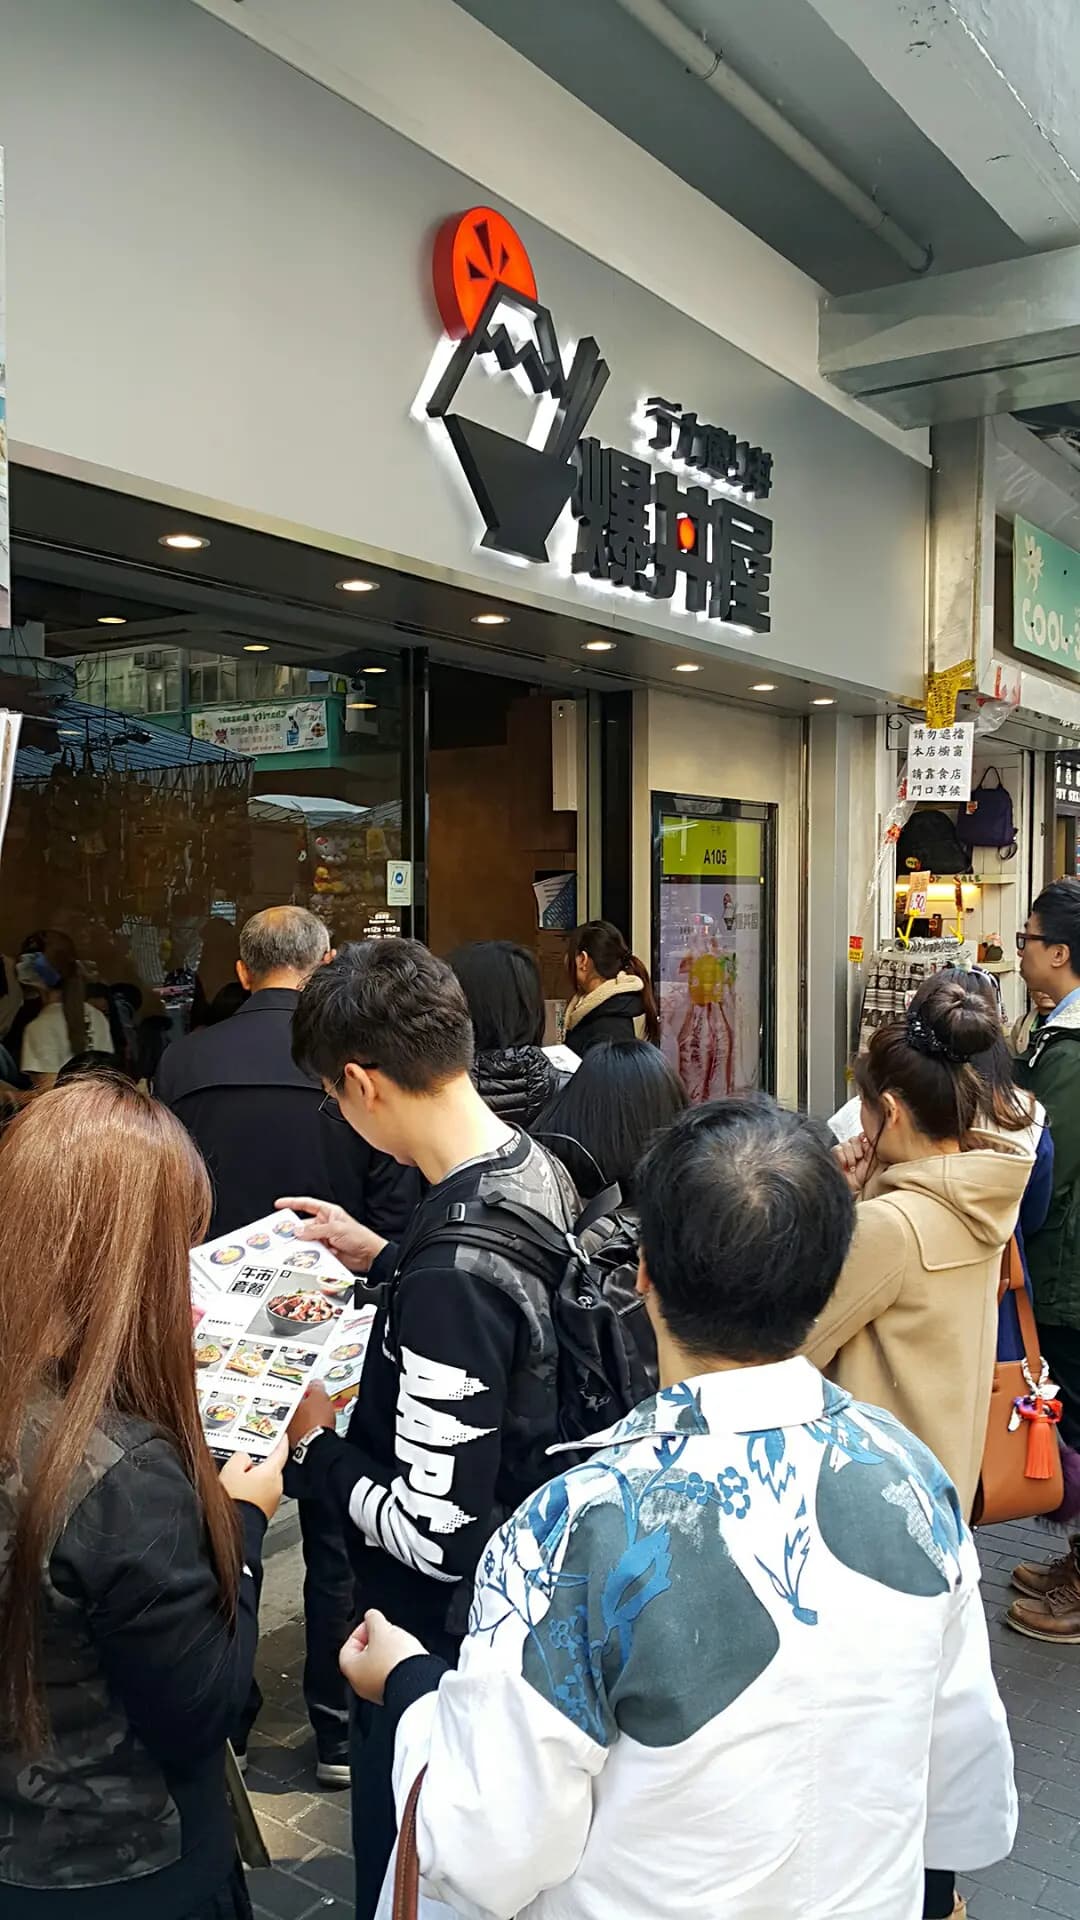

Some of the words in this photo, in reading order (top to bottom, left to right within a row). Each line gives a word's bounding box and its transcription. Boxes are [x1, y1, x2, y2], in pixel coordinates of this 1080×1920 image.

[571, 436, 773, 633] 爆丼屋
[911, 767, 963, 780] 請靠食店
[911, 784, 962, 797] 門口等候
[703, 849, 727, 865] A105
[241, 1266, 274, 1282] 午市
